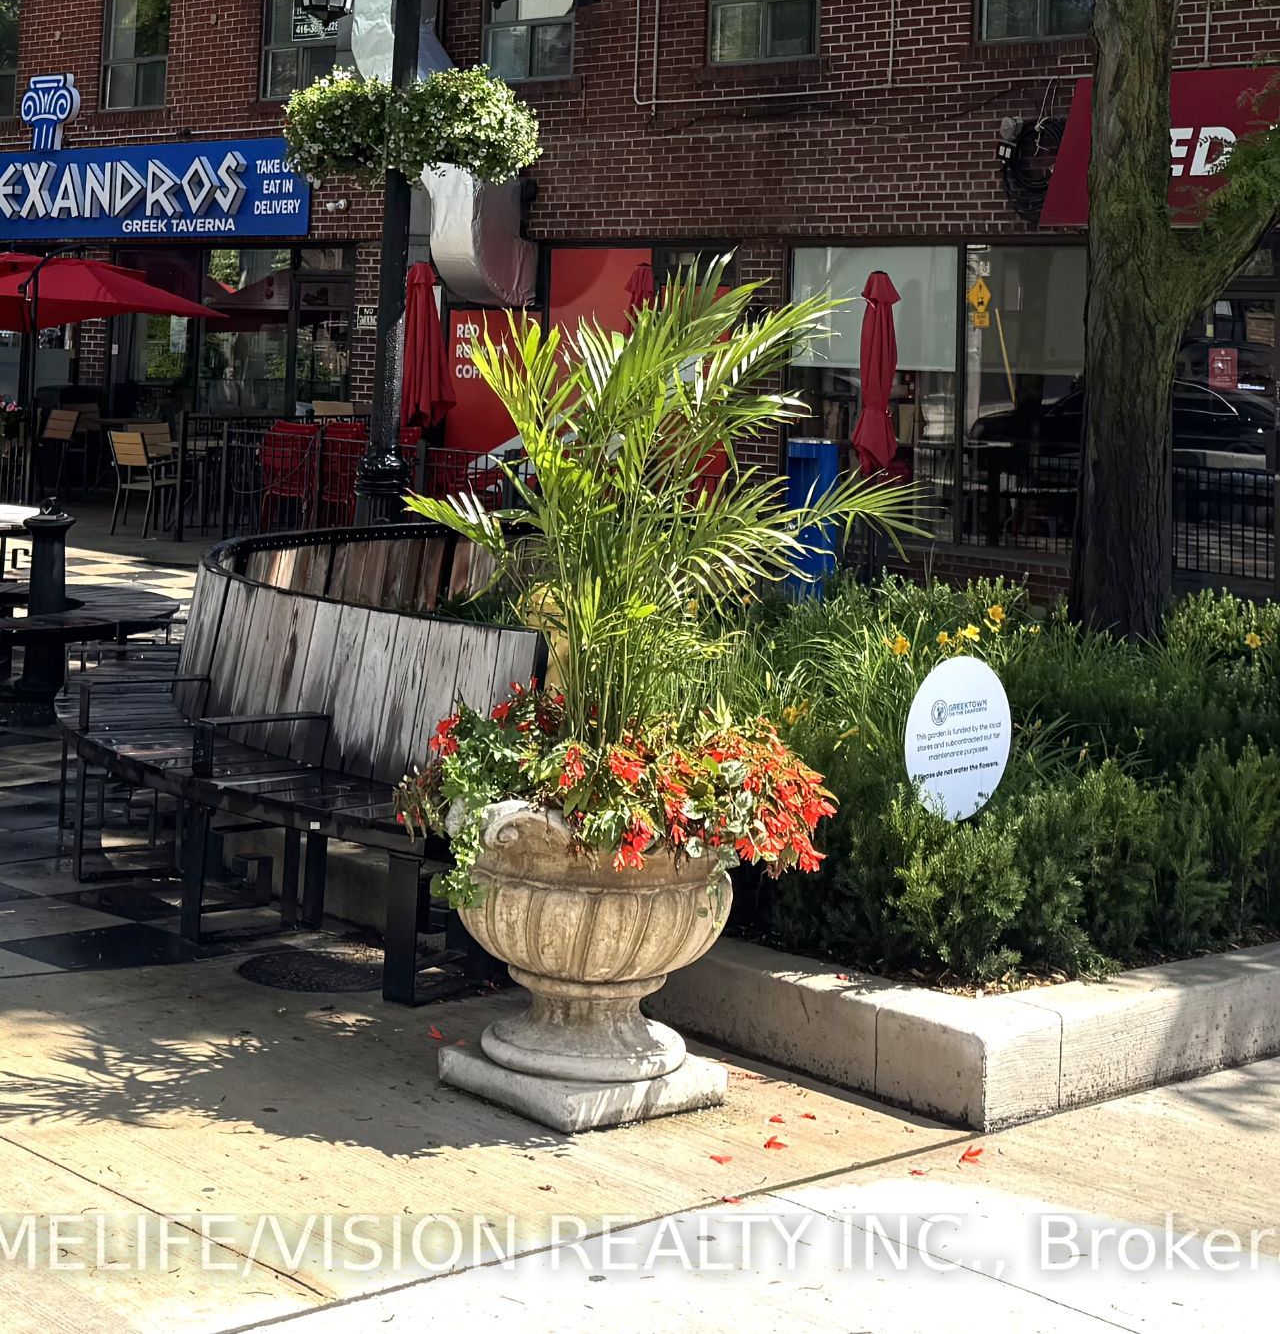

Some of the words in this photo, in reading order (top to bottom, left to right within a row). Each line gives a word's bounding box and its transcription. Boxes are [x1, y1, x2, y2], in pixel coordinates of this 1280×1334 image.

[1170, 126, 1237, 177] ED
[256, 159, 280, 174] TAKE
[263, 179, 281, 194] EAT
[282, 178, 293, 193] IN
[254, 198, 301, 215] DELIVERY
[122, 219, 168, 234] GREEK
[171, 218, 236, 233] TAVERNA
[363, 307, 374, 315] NO
[456, 323, 480, 338] RED
[949, 699, 988, 711] GREEKTOWN
[917, 733, 926, 741] This
[928, 730, 947, 741] garden
[952, 726, 971, 735] funded
[980, 723, 988, 731] the
[989, 721, 1002, 729] local
[917, 743, 933, 752] stores
[934, 742, 944, 750] and
[946, 735, 983, 748] subcontracted
[929, 750, 964, 761] maintenance
[954, 766, 968, 774] water
